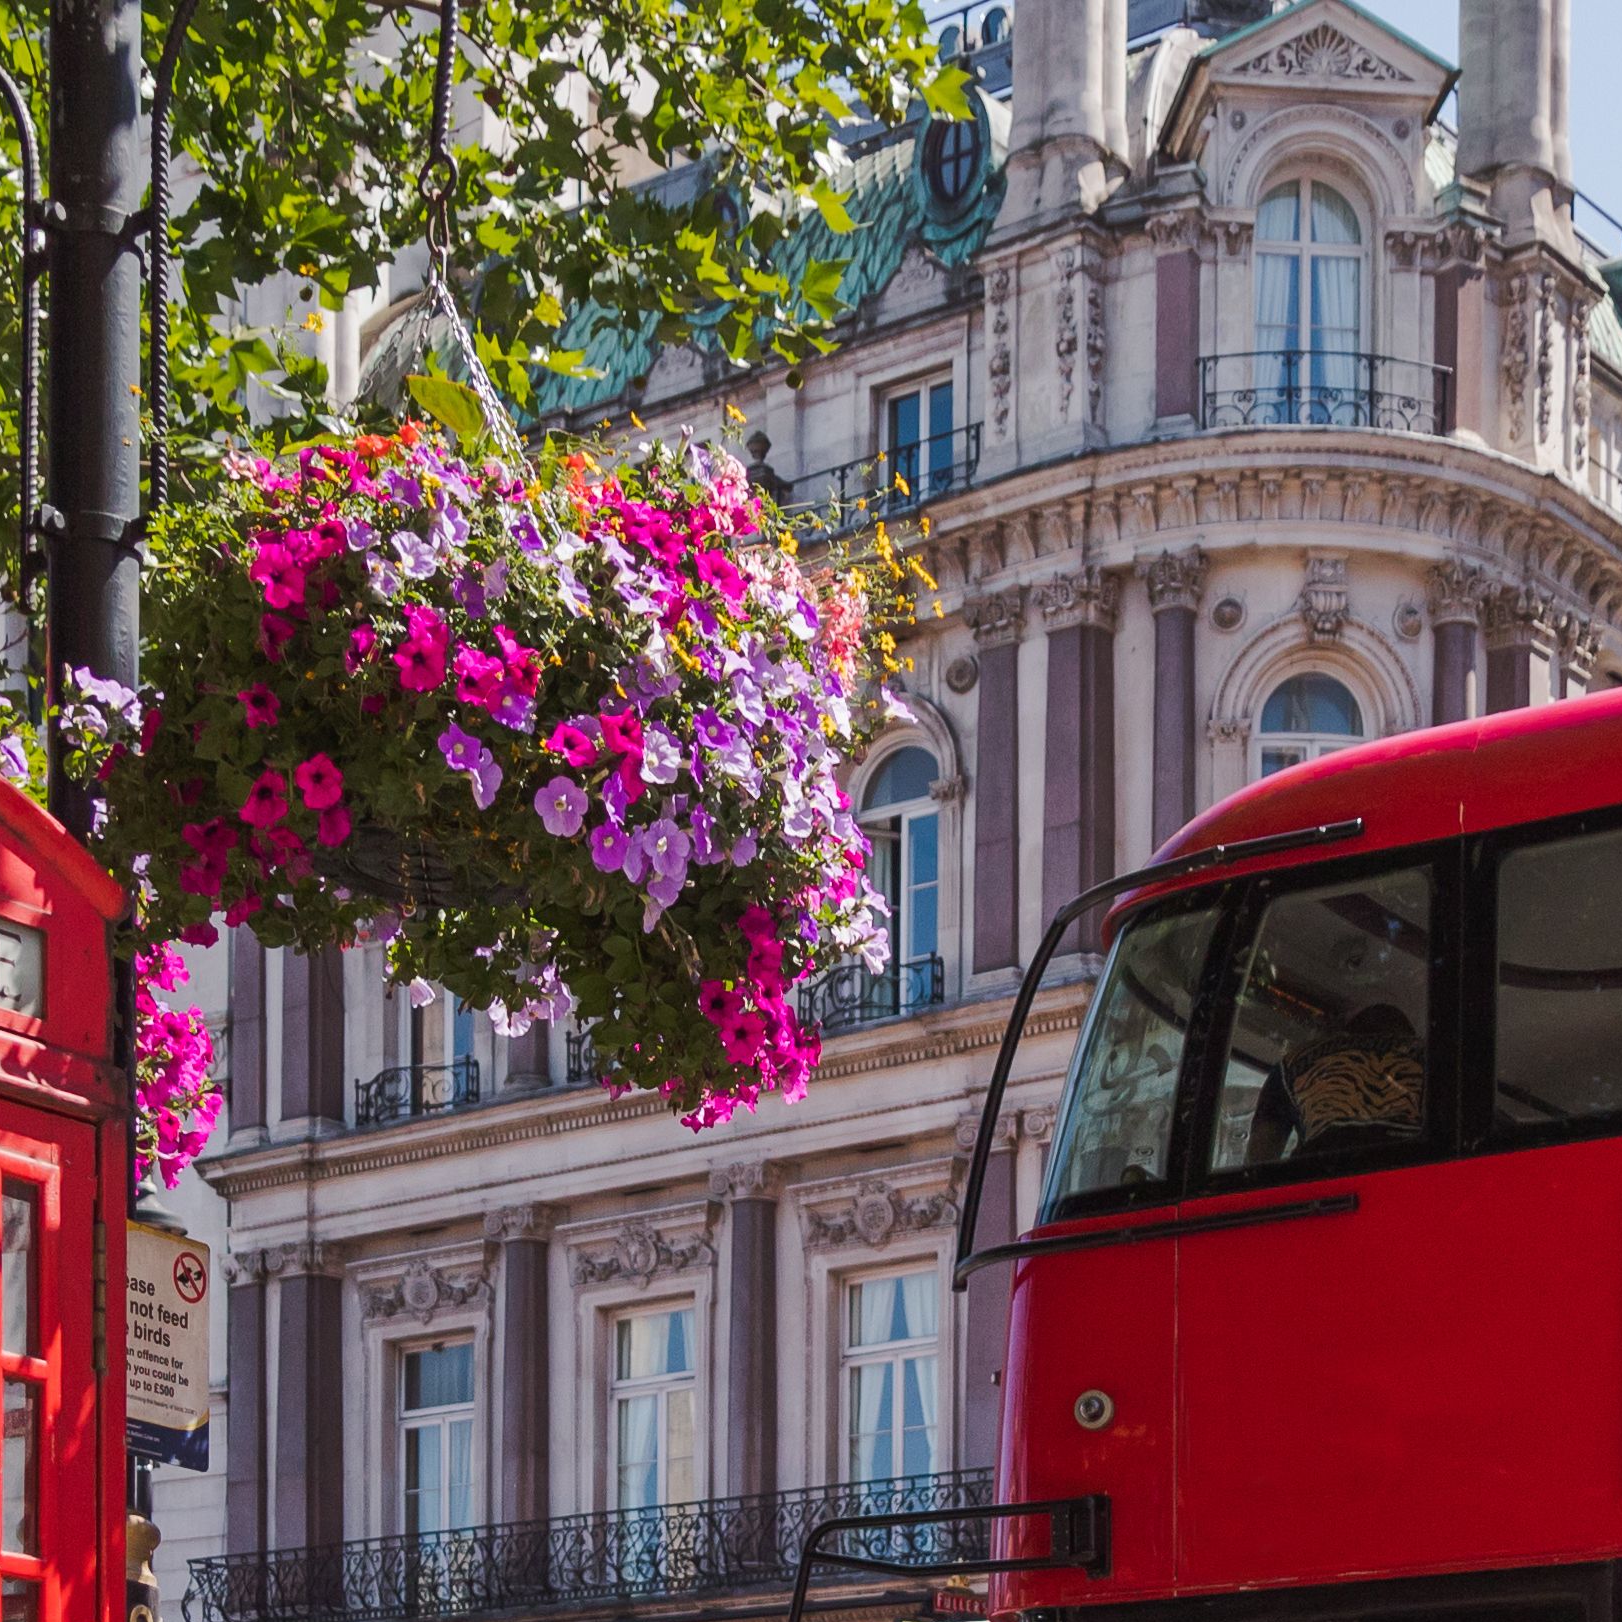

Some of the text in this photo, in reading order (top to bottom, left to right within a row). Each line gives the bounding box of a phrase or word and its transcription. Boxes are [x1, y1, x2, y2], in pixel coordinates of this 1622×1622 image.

[130, 1300, 189, 1329] not feed
[134, 1320, 170, 1347] birds
[137, 1350, 169, 1365] offence
[171, 1357, 184, 1370] for
[134, 1365, 150, 1376] you
[152, 1369, 176, 1383] could
[178, 1374, 189, 1386] be
[129, 1378, 175, 1398] up to £500
